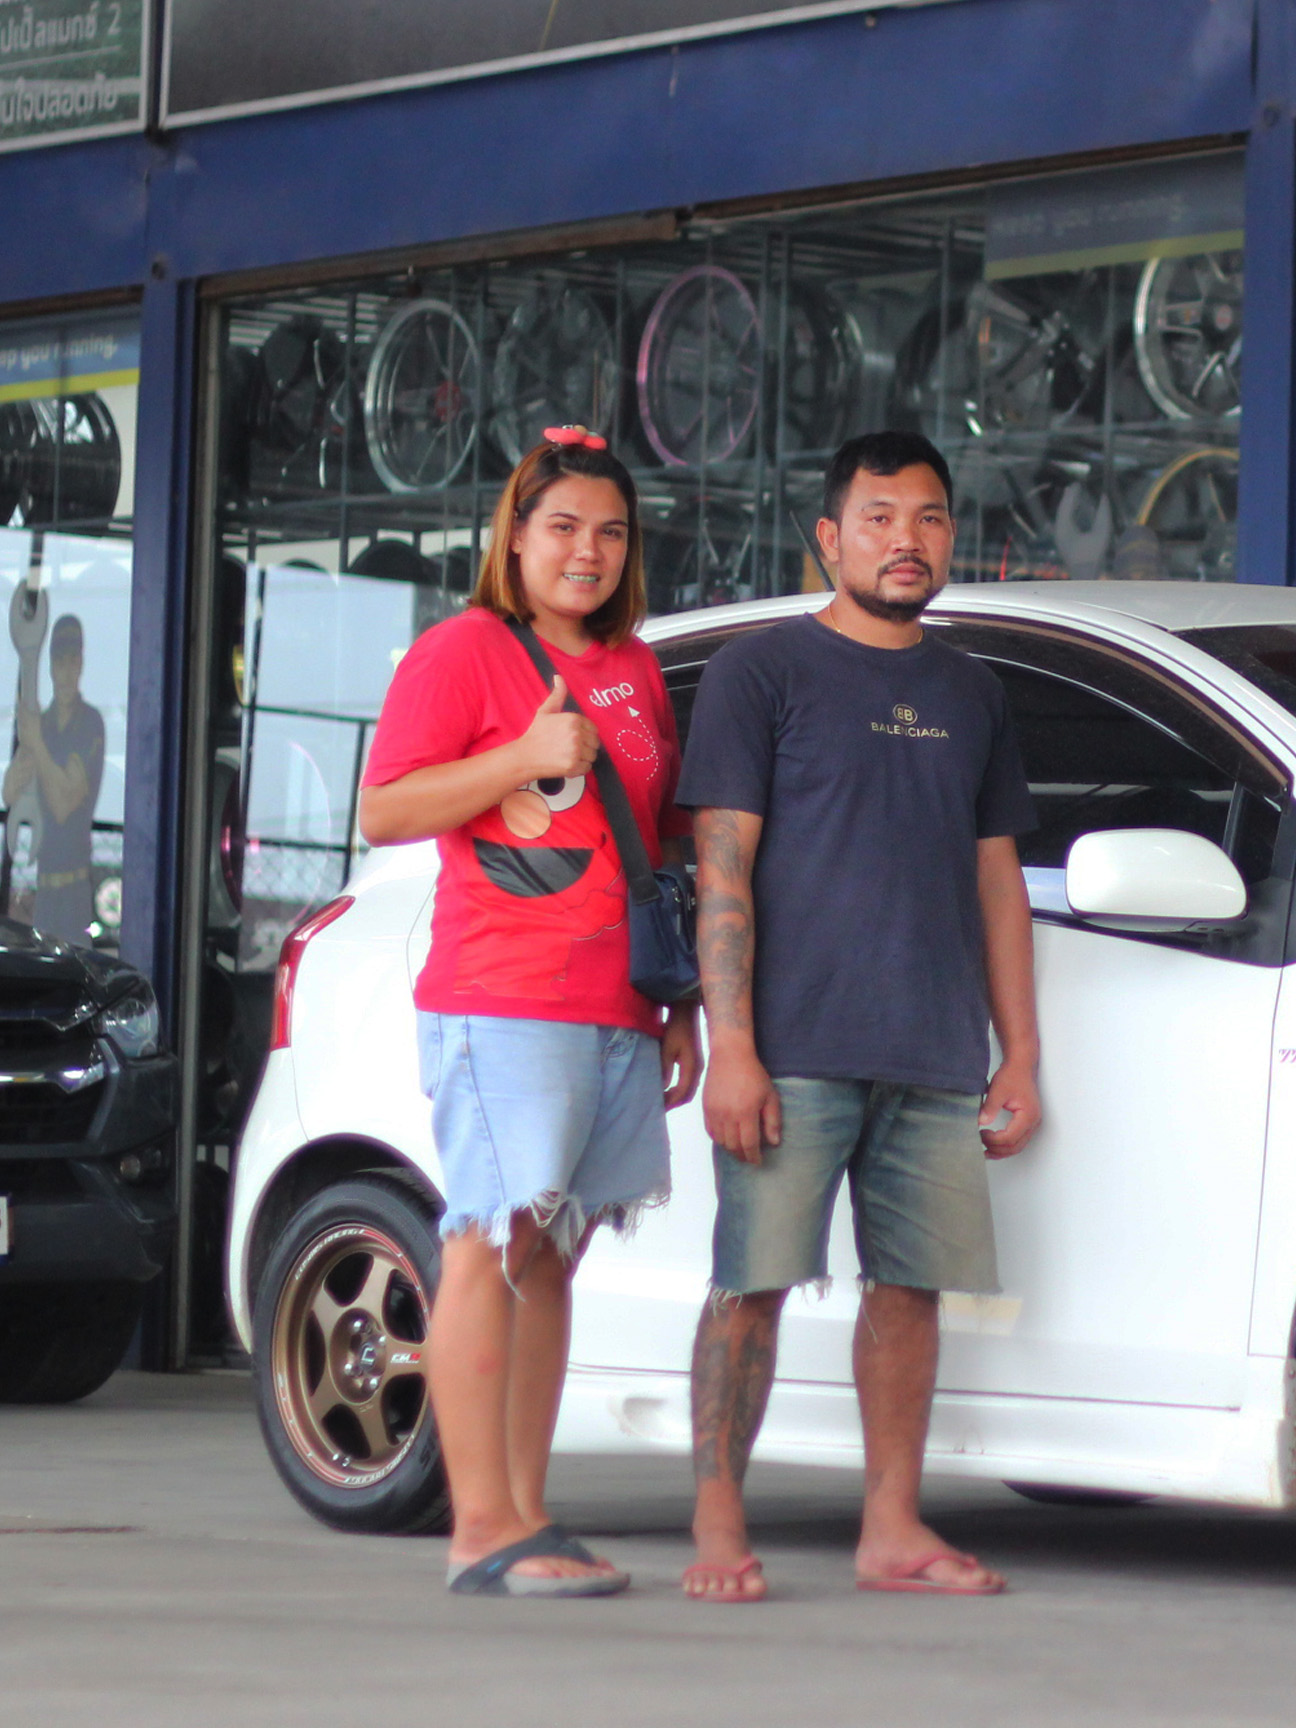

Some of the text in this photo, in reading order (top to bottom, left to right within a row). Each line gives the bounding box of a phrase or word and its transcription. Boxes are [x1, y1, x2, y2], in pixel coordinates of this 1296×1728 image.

[107, 2, 121, 35] 2
[589, 682, 634, 707] elmo
[871, 722, 949, 738] BALENCIAGA
